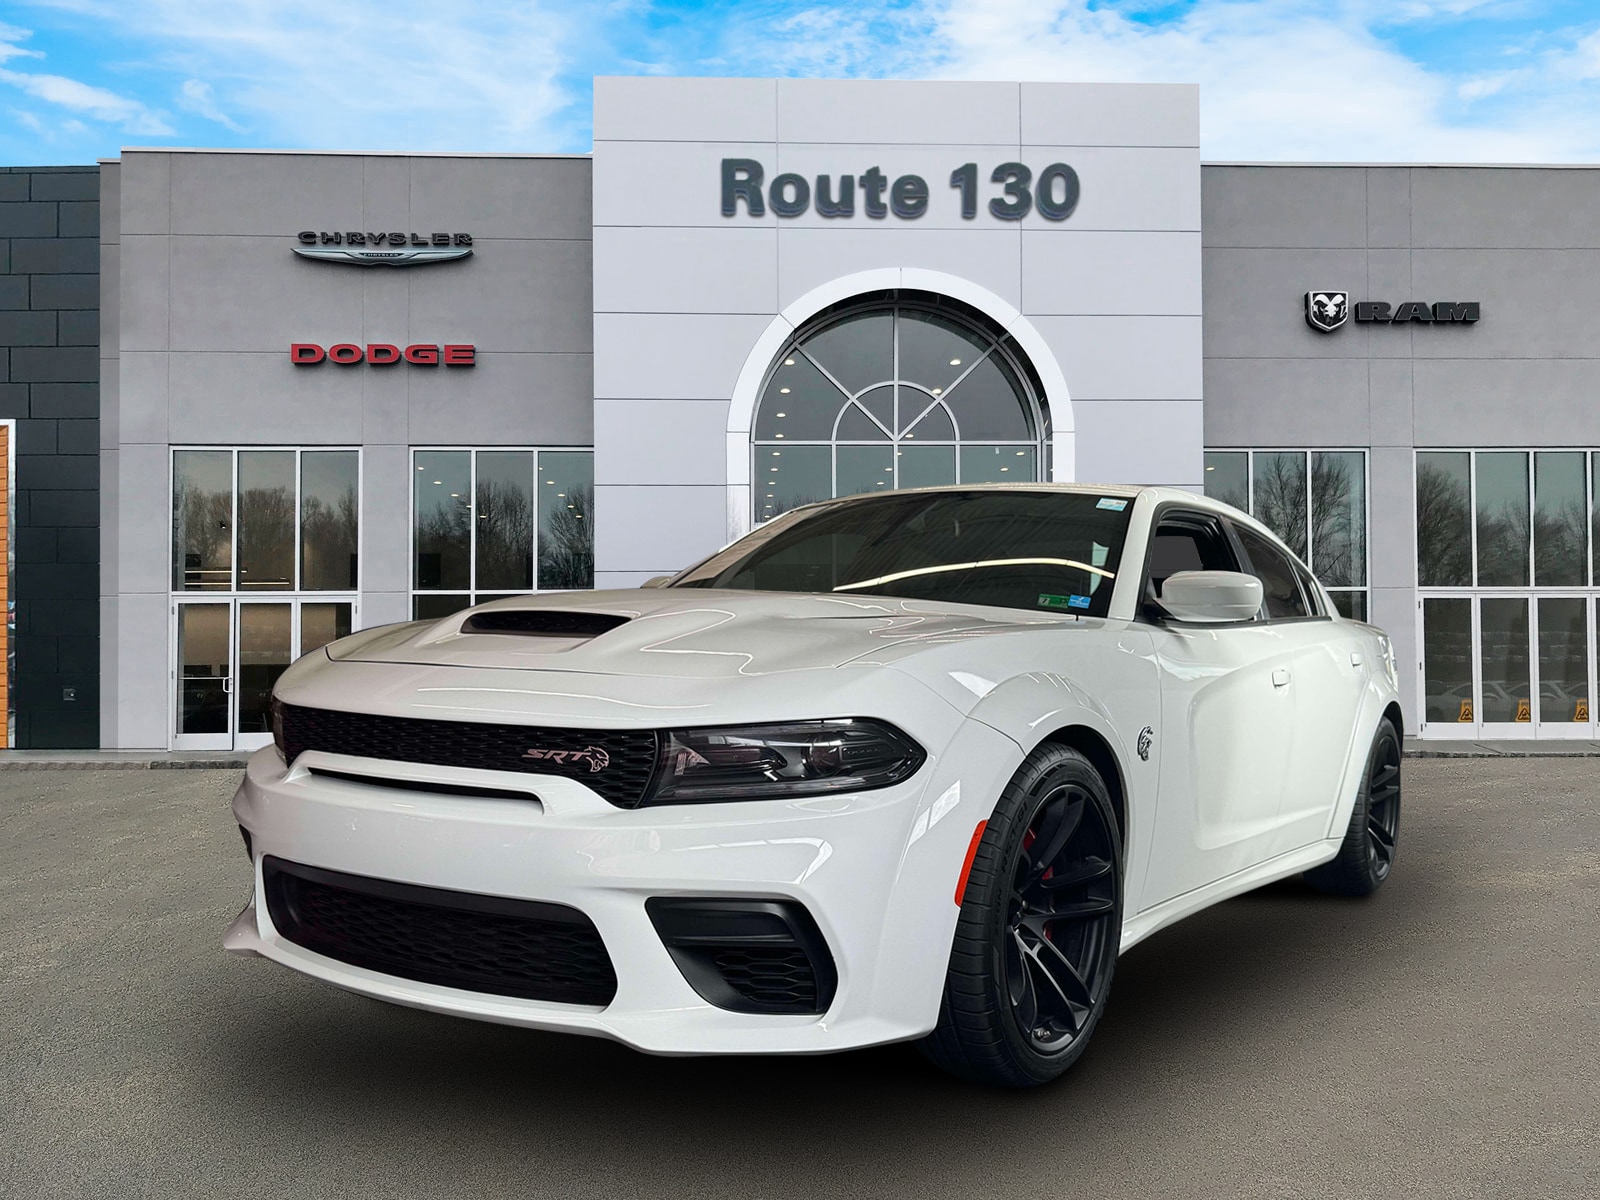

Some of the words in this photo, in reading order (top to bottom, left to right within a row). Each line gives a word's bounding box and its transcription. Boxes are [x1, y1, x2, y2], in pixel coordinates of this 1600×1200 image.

[721, 158, 929, 218] Route
[950, 162, 1080, 221] 130
[298, 231, 473, 245] CHRYSLER
[1355, 301, 1480, 325] RAM
[290, 343, 476, 366] DODGE
[521, 748, 591, 764] SRT
